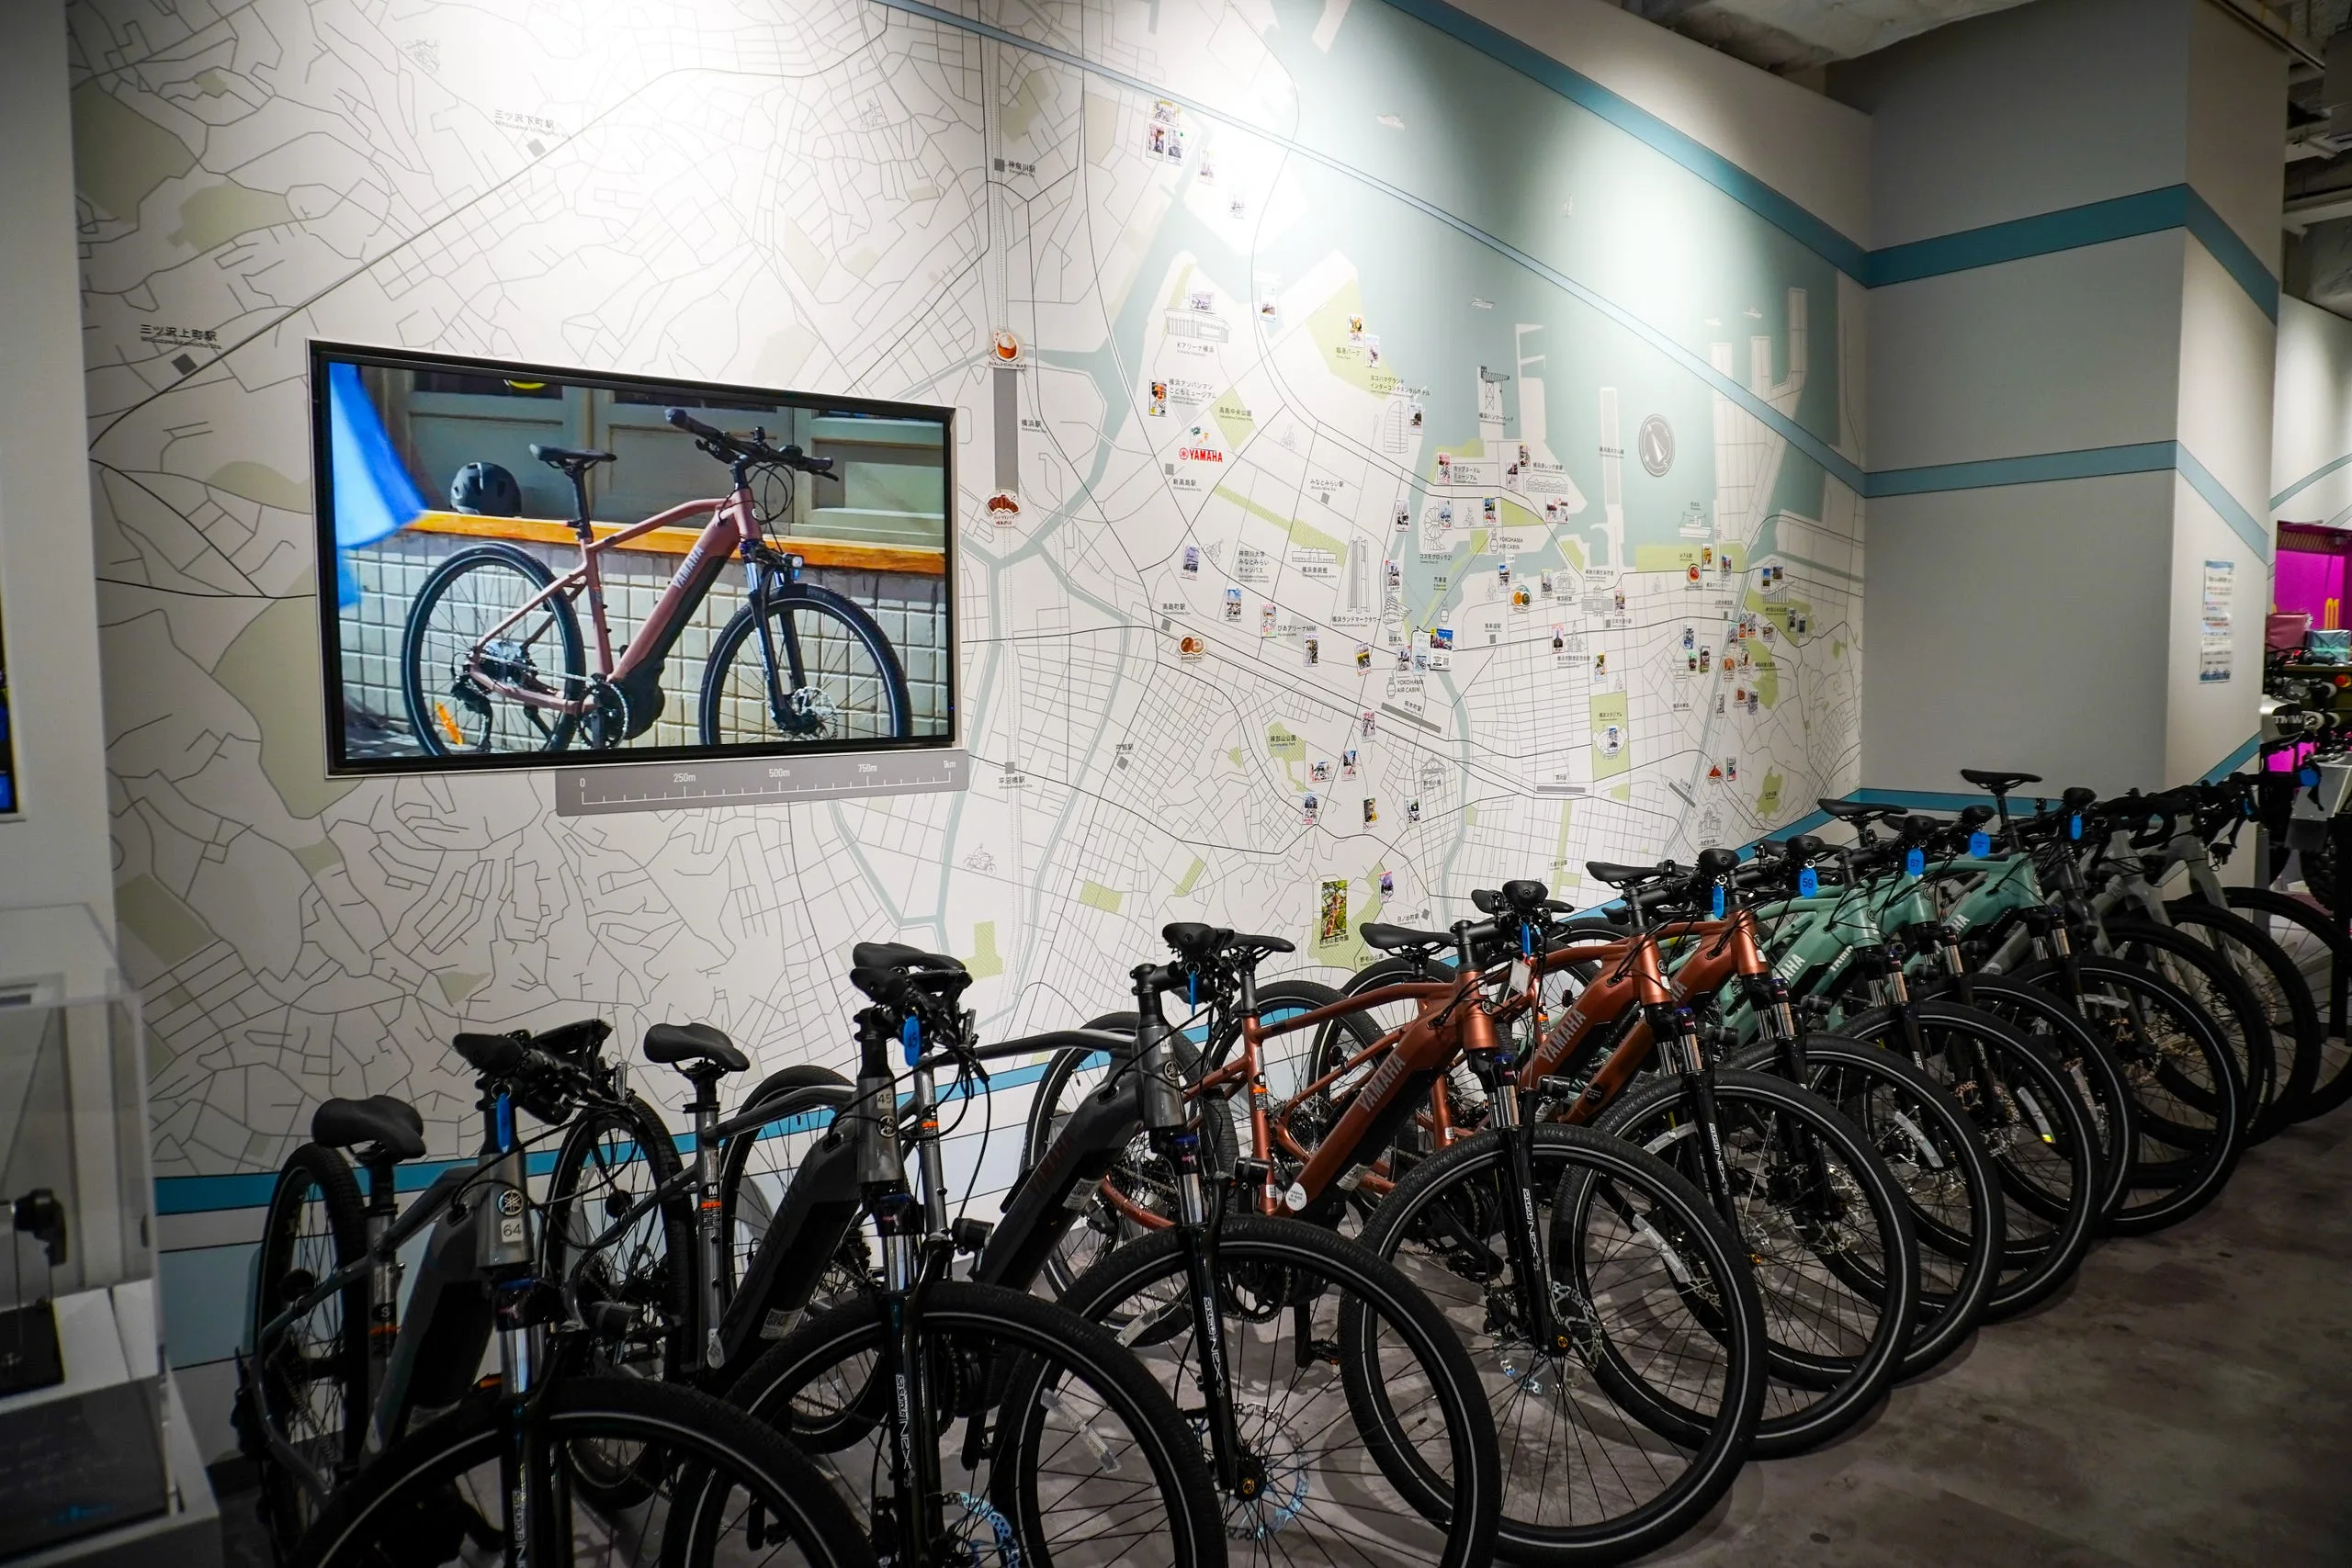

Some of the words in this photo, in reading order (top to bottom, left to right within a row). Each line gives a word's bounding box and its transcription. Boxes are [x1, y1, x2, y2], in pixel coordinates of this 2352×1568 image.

[494, 109, 555, 129] 三ツ沢下町駅
[1008, 160, 1036, 173] 神奈川駅
[140, 324, 217, 341] 三ツ沢上町駅
[1169, 378, 1213, 390] 横浜アンパンマン
[1169, 388, 1216, 399] こどもミュージアム
[1021, 419, 1042, 428] 横浜駅
[1189, 448, 1223, 462] YAMAHA
[1309, 479, 1344, 488] みなとみらい駅
[672, 545, 705, 589] YAMAHA
[1238, 558, 1270, 566] みなとみらい
[1238, 566, 1264, 574] キャンパス
[1162, 603, 1186, 611] 高島町駅
[857, 763, 877, 773] 750m
[943, 760, 956, 770] 1km
[673, 773, 695, 783] 250m
[768, 768, 790, 778] 500m
[580, 777, 585, 787] 0
[1802, 877, 1814, 888] 59
[1540, 1009, 1587, 1064] YAMAHA
[1360, 1054, 1407, 1112] YAMAHA
[877, 1093, 892, 1104] 45
[707, 1186, 718, 1196] M
[503, 1224, 522, 1237] 64
[381, 1307, 390, 1317] S
[1209, 1337, 1223, 1382] NEX
[899, 1421, 911, 1470] NEX
